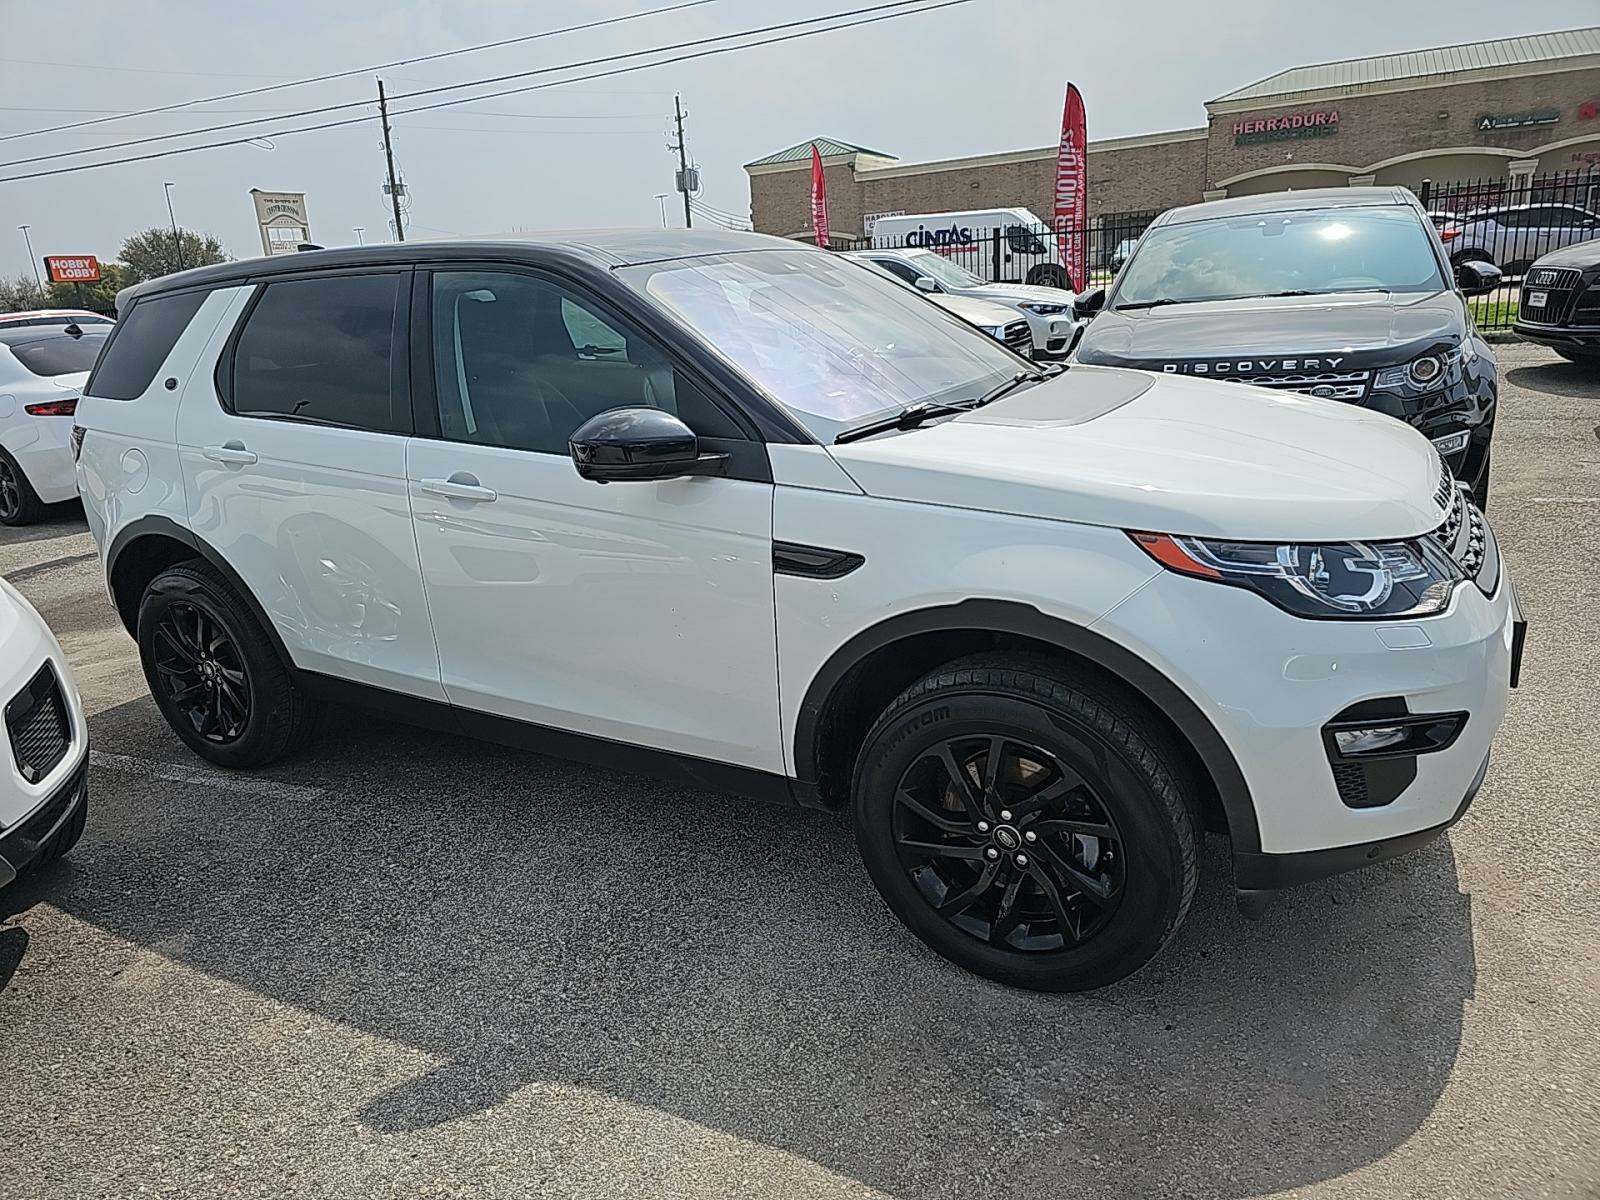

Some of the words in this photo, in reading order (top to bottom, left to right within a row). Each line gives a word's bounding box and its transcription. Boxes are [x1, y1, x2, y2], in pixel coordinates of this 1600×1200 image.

[1233, 111, 1339, 135] HERRADURA
[1055, 127, 1077, 208] MOTORS
[906, 222, 971, 247] CINTAS
[50, 259, 90, 269] HOBBY
[59, 268, 96, 278] LOBBY
[1163, 357, 1344, 373] DISCOVERY
